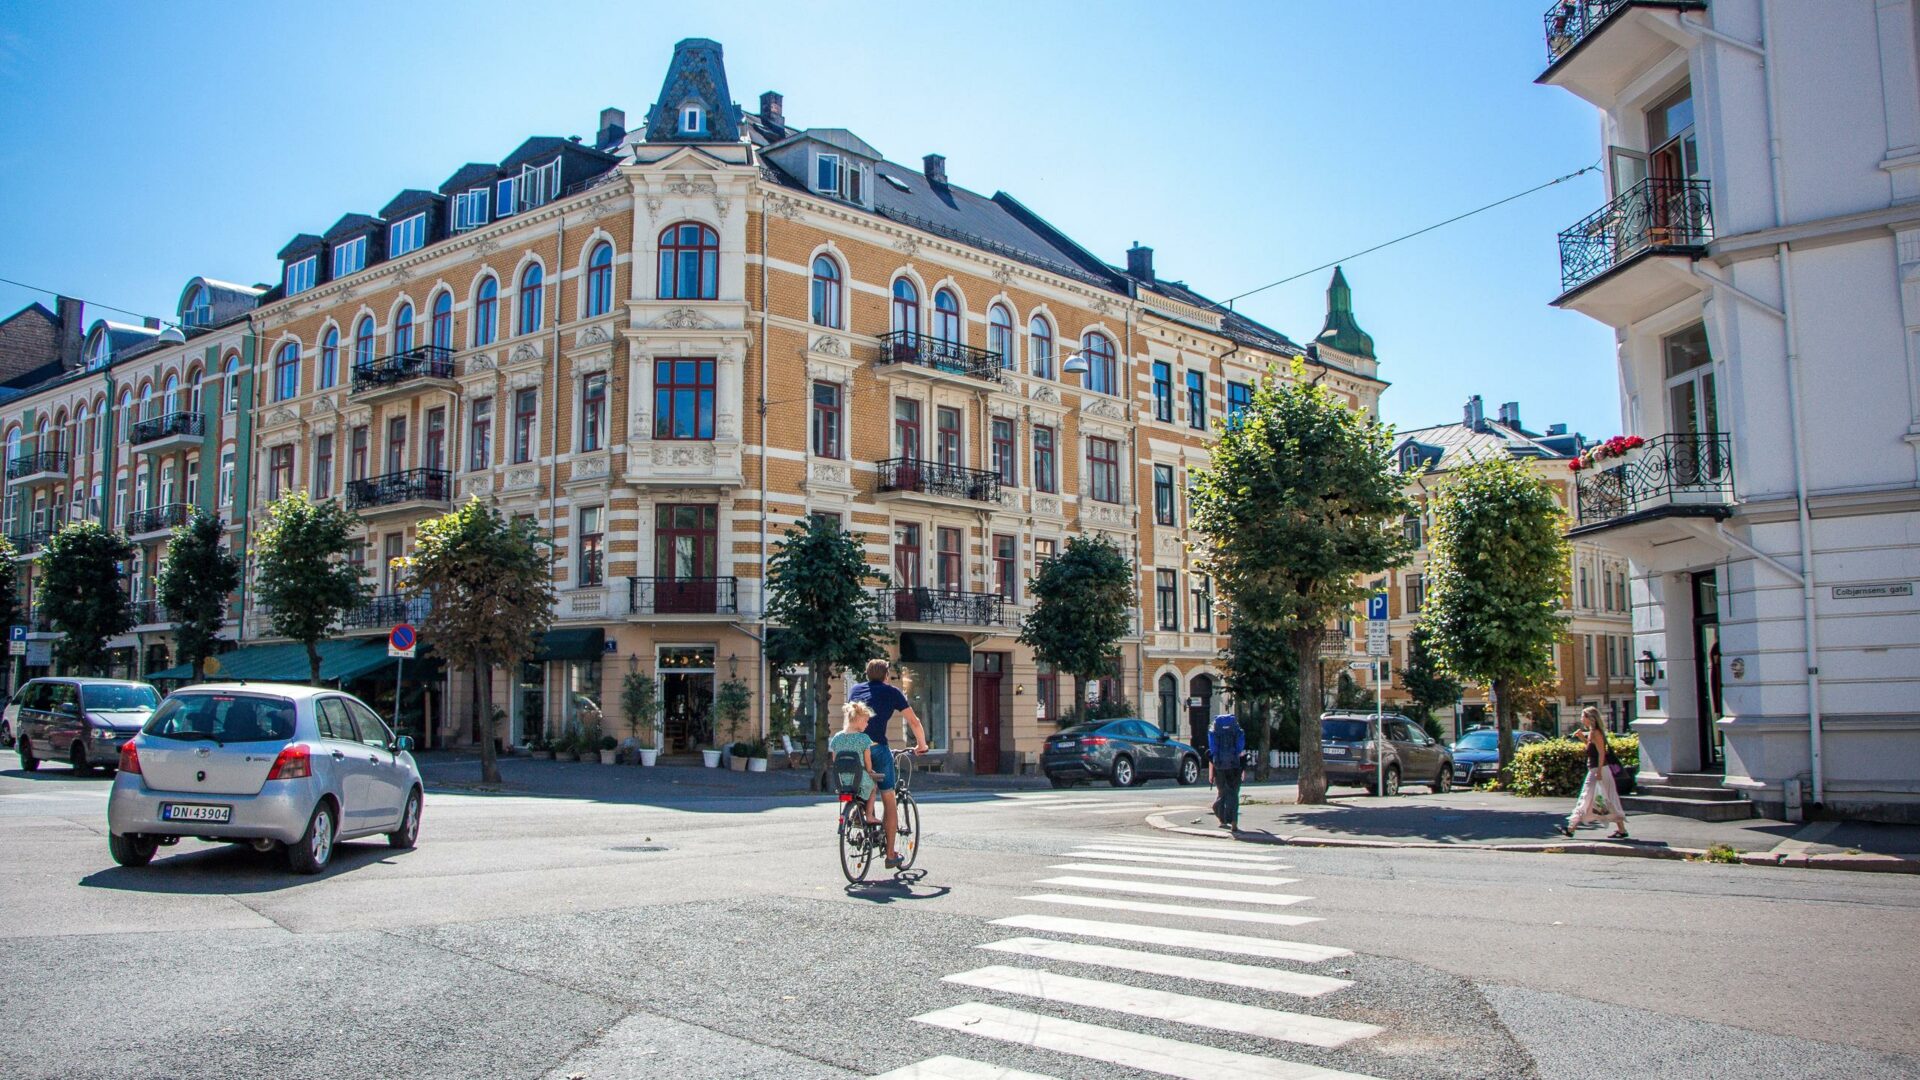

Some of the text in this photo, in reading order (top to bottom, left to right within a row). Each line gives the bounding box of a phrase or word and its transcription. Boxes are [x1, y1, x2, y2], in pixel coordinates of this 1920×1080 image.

[1836, 586, 1908, 596] Colbjørnsens gate
[1373, 597, 1383, 616] P
[14, 627, 23, 639] P
[173, 807, 228, 819] DN 43904
